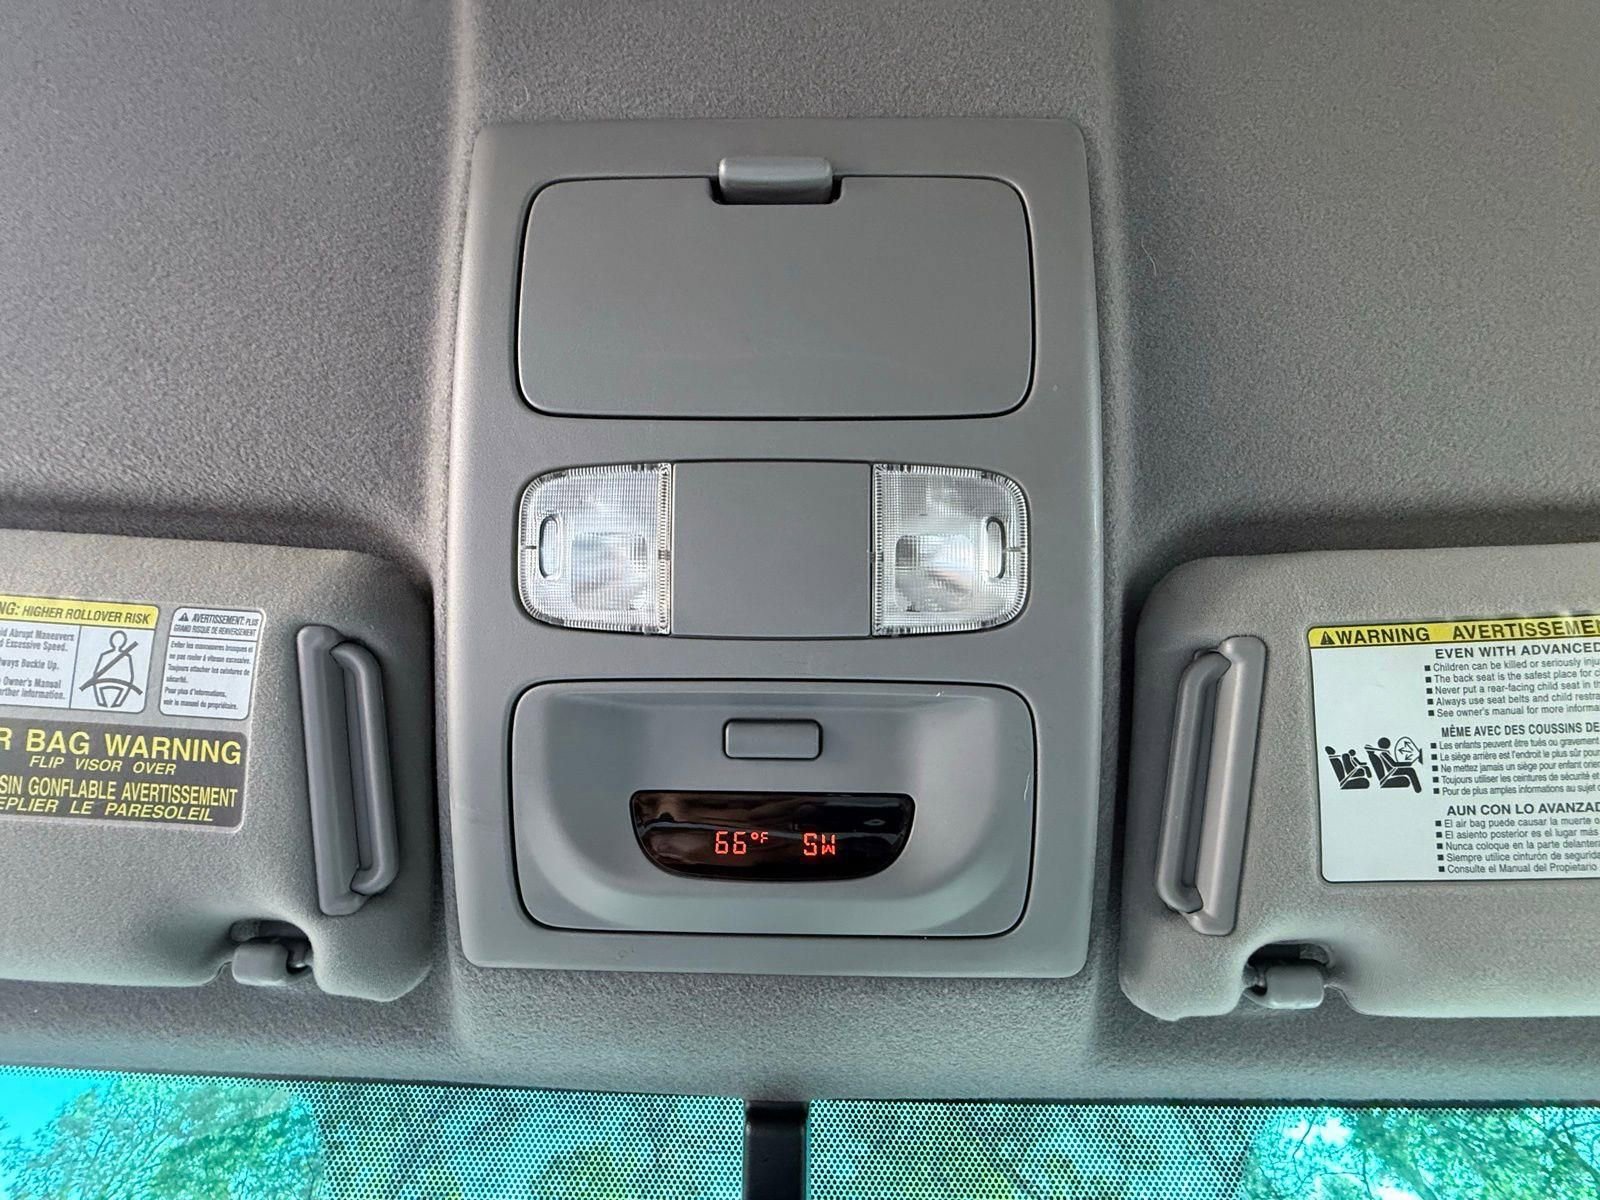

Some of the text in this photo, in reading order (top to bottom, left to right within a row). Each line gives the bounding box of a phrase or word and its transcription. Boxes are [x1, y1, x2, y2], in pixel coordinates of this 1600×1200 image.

[22, 606, 63, 618] HIGHER
[65, 608, 122, 622] ROLLOVER
[124, 613, 150, 624] RISK
[1336, 628, 1430, 645] WARNING
[1435, 643, 1600, 659] EVEN WITH ADVANCED
[1433, 663, 1469, 672] Children
[1490, 661, 1501, 669] be
[1504, 660, 1527, 668] killed
[1542, 658, 1581, 668] seriously
[1434, 674, 1450, 683] The
[1453, 674, 1473, 682] back
[1508, 672, 1522, 680] the
[1525, 671, 1550, 679] safest
[1553, 670, 1577, 679] place
[1580, 669, 1591, 677] for
[1435, 686, 1463, 694] Never
[1463, 686, 1476, 695] put
[1488, 683, 1534, 693] rear-facing
[1538, 682, 1558, 690] child
[1561, 681, 1580, 689] seat
[1436, 697, 1466, 707] Always
[1509, 694, 1529, 703] belts
[1533, 694, 1548, 702] and
[1552, 693, 1572, 701] child
[1437, 709, 1454, 717] See
[1457, 708, 1489, 716] owner's
[1492, 705, 1524, 715] manual
[1527, 706, 1538, 714] for
[1541, 705, 1563, 713] more
[1441, 722, 1600, 737] MÊME AVEC DES COUSSINS DE
[26, 729, 89, 755] BAG
[105, 733, 241, 765] WARNING
[29, 756, 176, 775] FLIP VISOR OVER
[1441, 764, 1451, 772] Ne
[1453, 764, 1478, 772] mettez
[1480, 762, 1504, 773] jamais
[1517, 761, 1537, 772] siège
[1539, 762, 1556, 771] pour
[1558, 760, 1581, 769] enfant
[1442, 775, 1472, 785] Toujours
[1474, 774, 1498, 783] utiliser
[1500, 774, 1511, 782] les
[1513, 772, 1547, 782] ceintures
[1549, 773, 1560, 781] de
[1561, 772, 1590, 780] sécurité
[28, 777, 116, 800] GONFLABLE
[121, 782, 238, 807] AVERTISSEMENT
[1443, 787, 1458, 796] Pour
[1461, 786, 1471, 795] de
[1473, 786, 1488, 797] plus
[1490, 785, 1516, 796] amples
[1518, 784, 1563, 793] informations
[1578, 784, 1596, 794] sujet
[70, 801, 94, 815] LE
[104, 802, 214, 821] PARESOLEIL
[1447, 805, 1476, 816] AUN
[1481, 804, 1511, 815] CON
[1516, 803, 1534, 814] LO
[1445, 819, 1453, 828] El
[1456, 819, 1466, 827] air
[1470, 819, 1486, 828] bag
[1489, 818, 1515, 828] puede
[1518, 818, 1546, 826] causar
[1550, 817, 1557, 825] la
[1561, 817, 1591, 825] muerte
[1445, 831, 1453, 839] El
[1457, 830, 1487, 838] asiento
[1491, 829, 1527, 839] posterior
[1531, 829, 1541, 837] es
[1545, 829, 1552, 837] el
[1555, 828, 1577, 838] lugar
[803, 833, 835, 856] SW
[1446, 842, 1473, 851] Nunca
[1476, 841, 1509, 851] coloque
[1526, 841, 1534, 849] la
[1537, 841, 1560, 850] parte
[1447, 853, 1482, 862] Siempre
[1485, 853, 1510, 861] utilice
[1551, 852, 1561, 860] de
[1448, 865, 1485, 874] Consulte
[1500, 864, 1530, 872] Manual
[1534, 864, 1547, 872] del
[1551, 863, 1596, 873] Propietario
